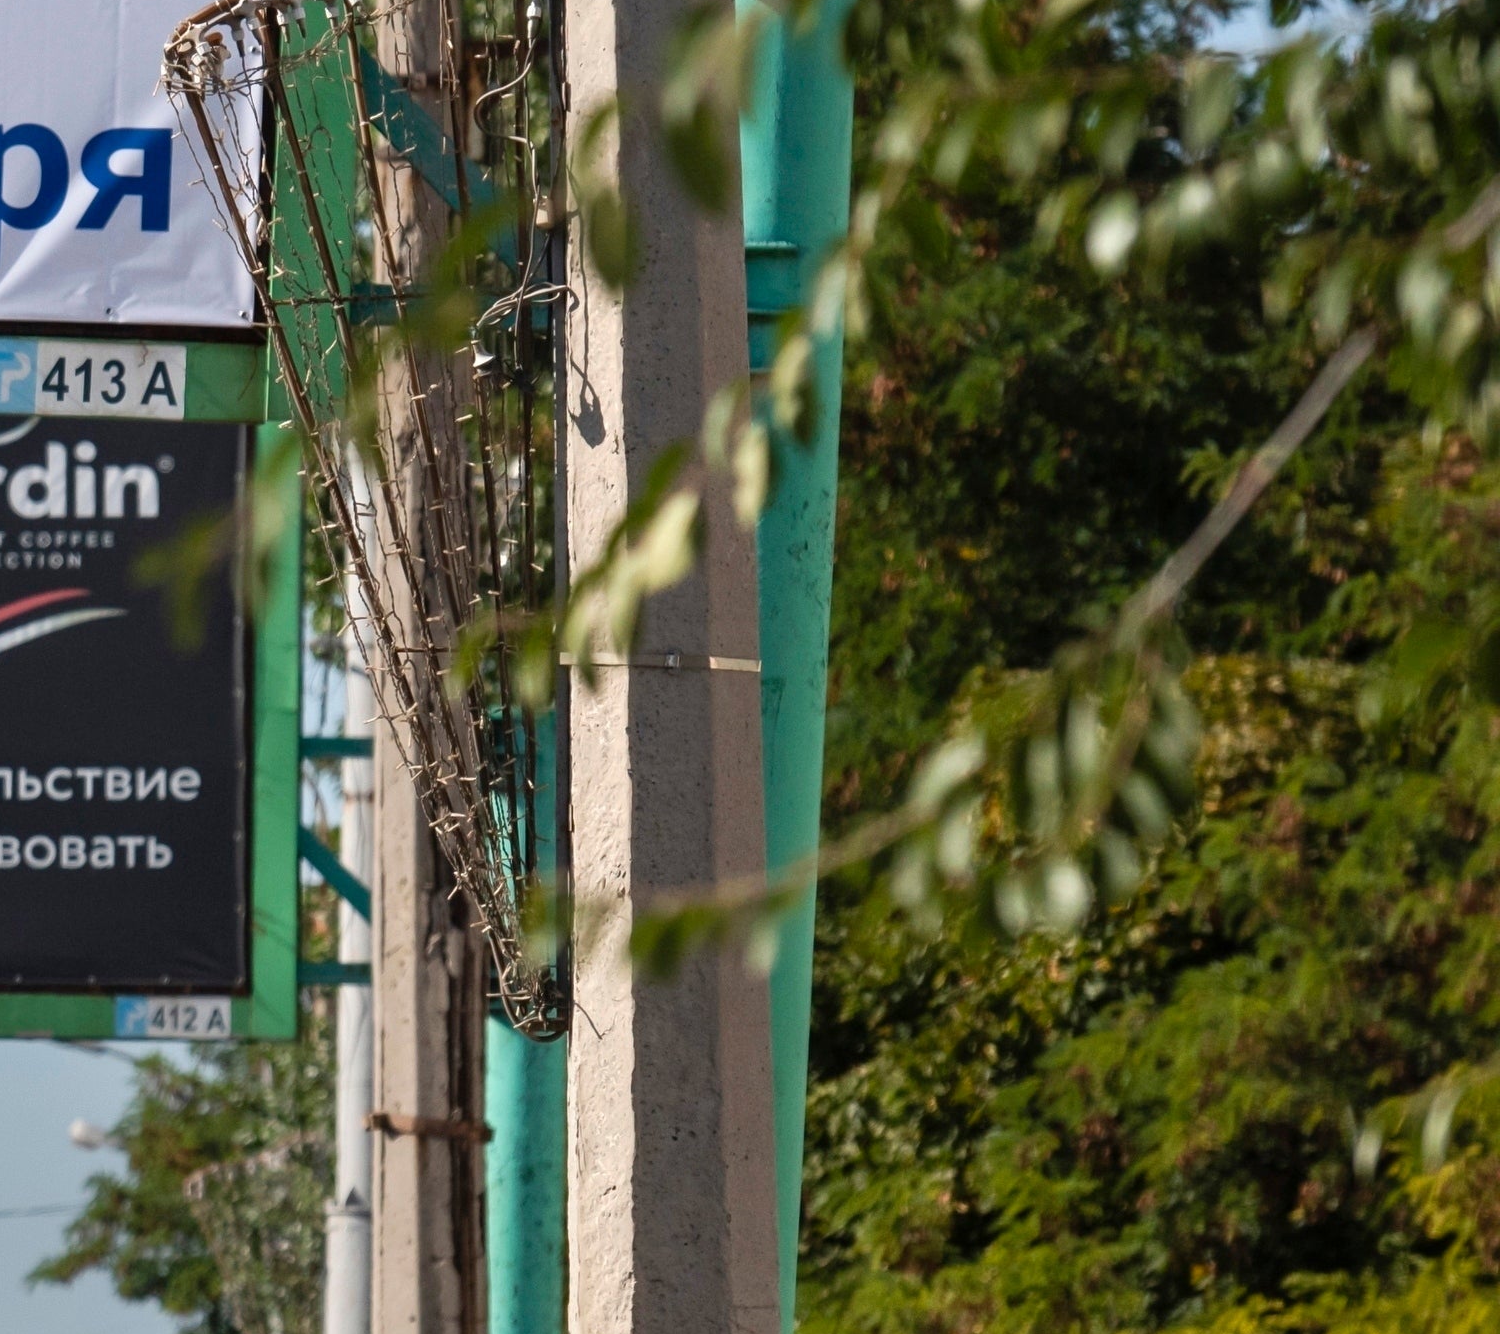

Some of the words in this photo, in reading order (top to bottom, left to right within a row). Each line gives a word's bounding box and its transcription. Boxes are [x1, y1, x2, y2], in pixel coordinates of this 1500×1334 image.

[41, 357, 126, 406] 413
[20, 531, 115, 548] COFFEE
[151, 1005, 197, 1032] 412
